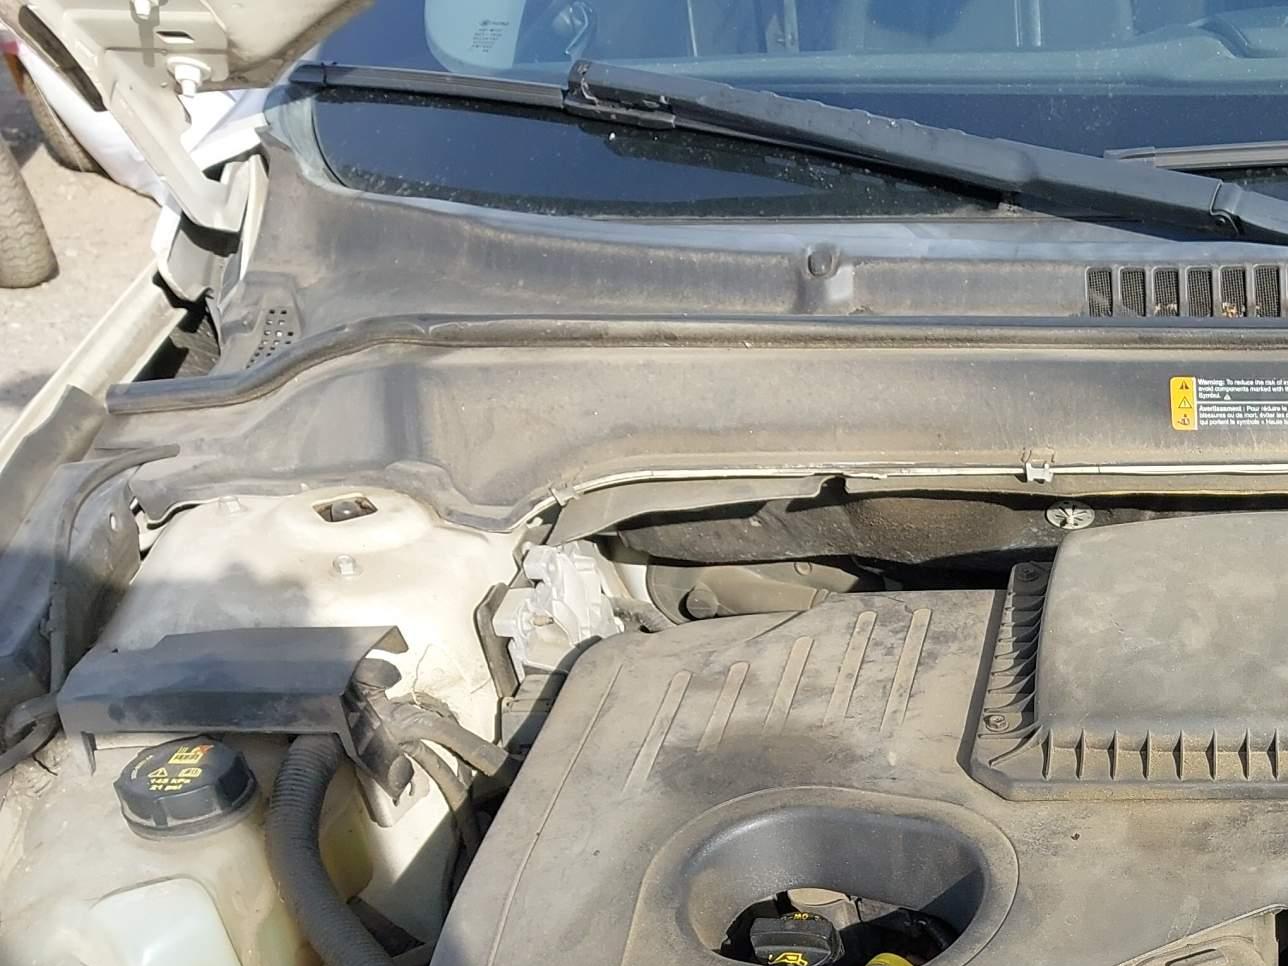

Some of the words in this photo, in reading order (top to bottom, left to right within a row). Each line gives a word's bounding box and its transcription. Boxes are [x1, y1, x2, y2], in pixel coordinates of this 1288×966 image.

[1226, 378, 1233, 386] To
[1234, 378, 1254, 386] reduce
[1254, 378, 1264, 386] the
[1276, 378, 1283, 386] of
